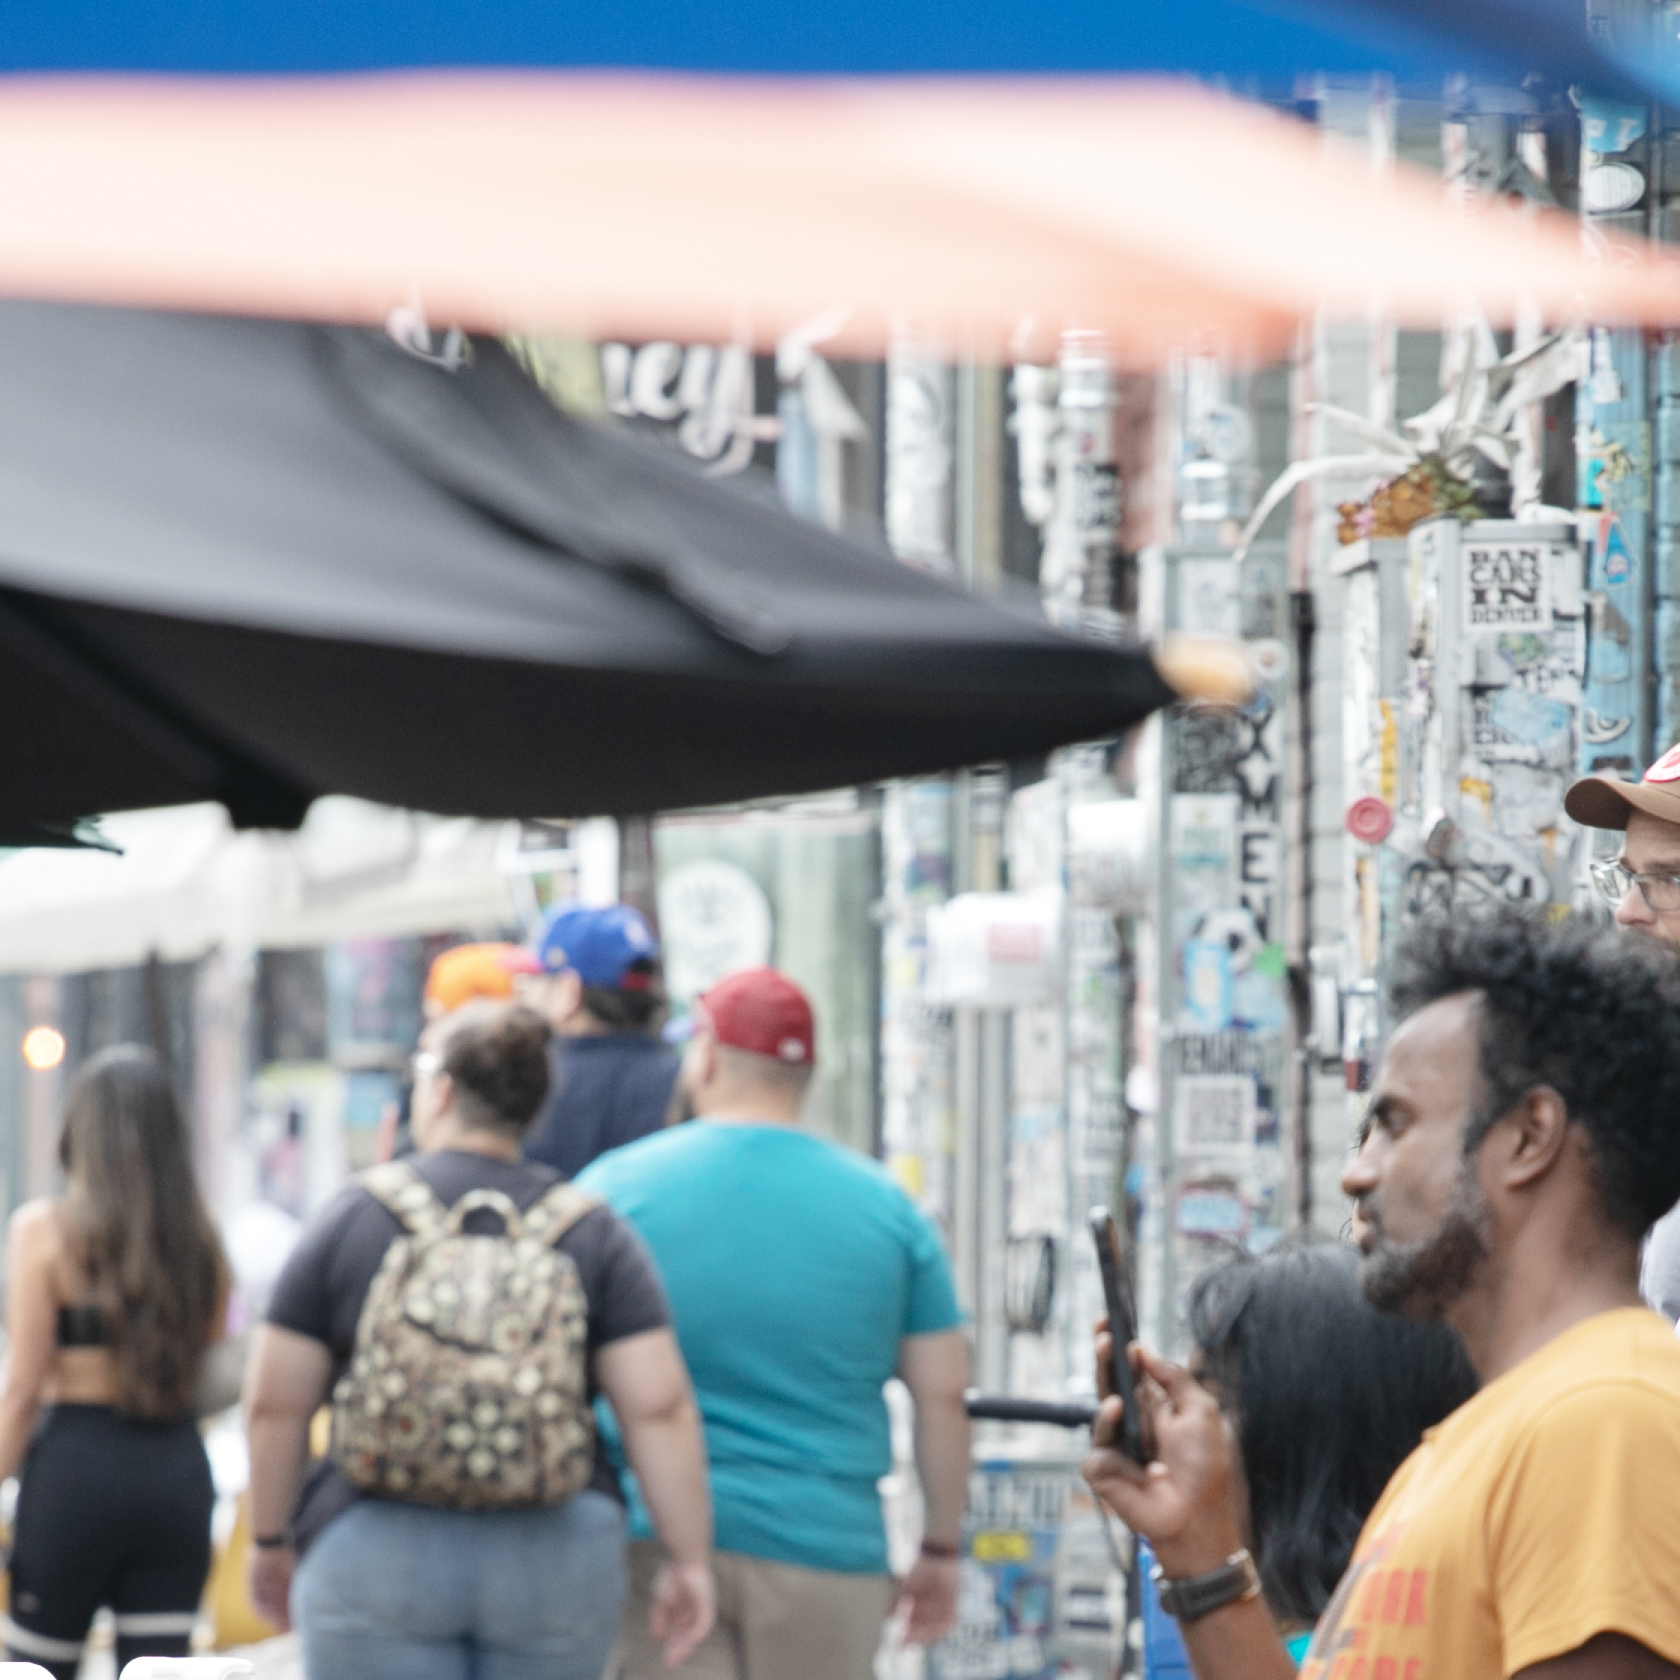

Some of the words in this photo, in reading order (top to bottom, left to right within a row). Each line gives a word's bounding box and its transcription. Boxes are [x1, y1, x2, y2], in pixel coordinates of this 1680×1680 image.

[1471, 550, 1538, 564] BAN
[1471, 564, 1541, 584] CARS
[1472, 588, 1538, 604] IN
[1471, 608, 1541, 623] DENVER
